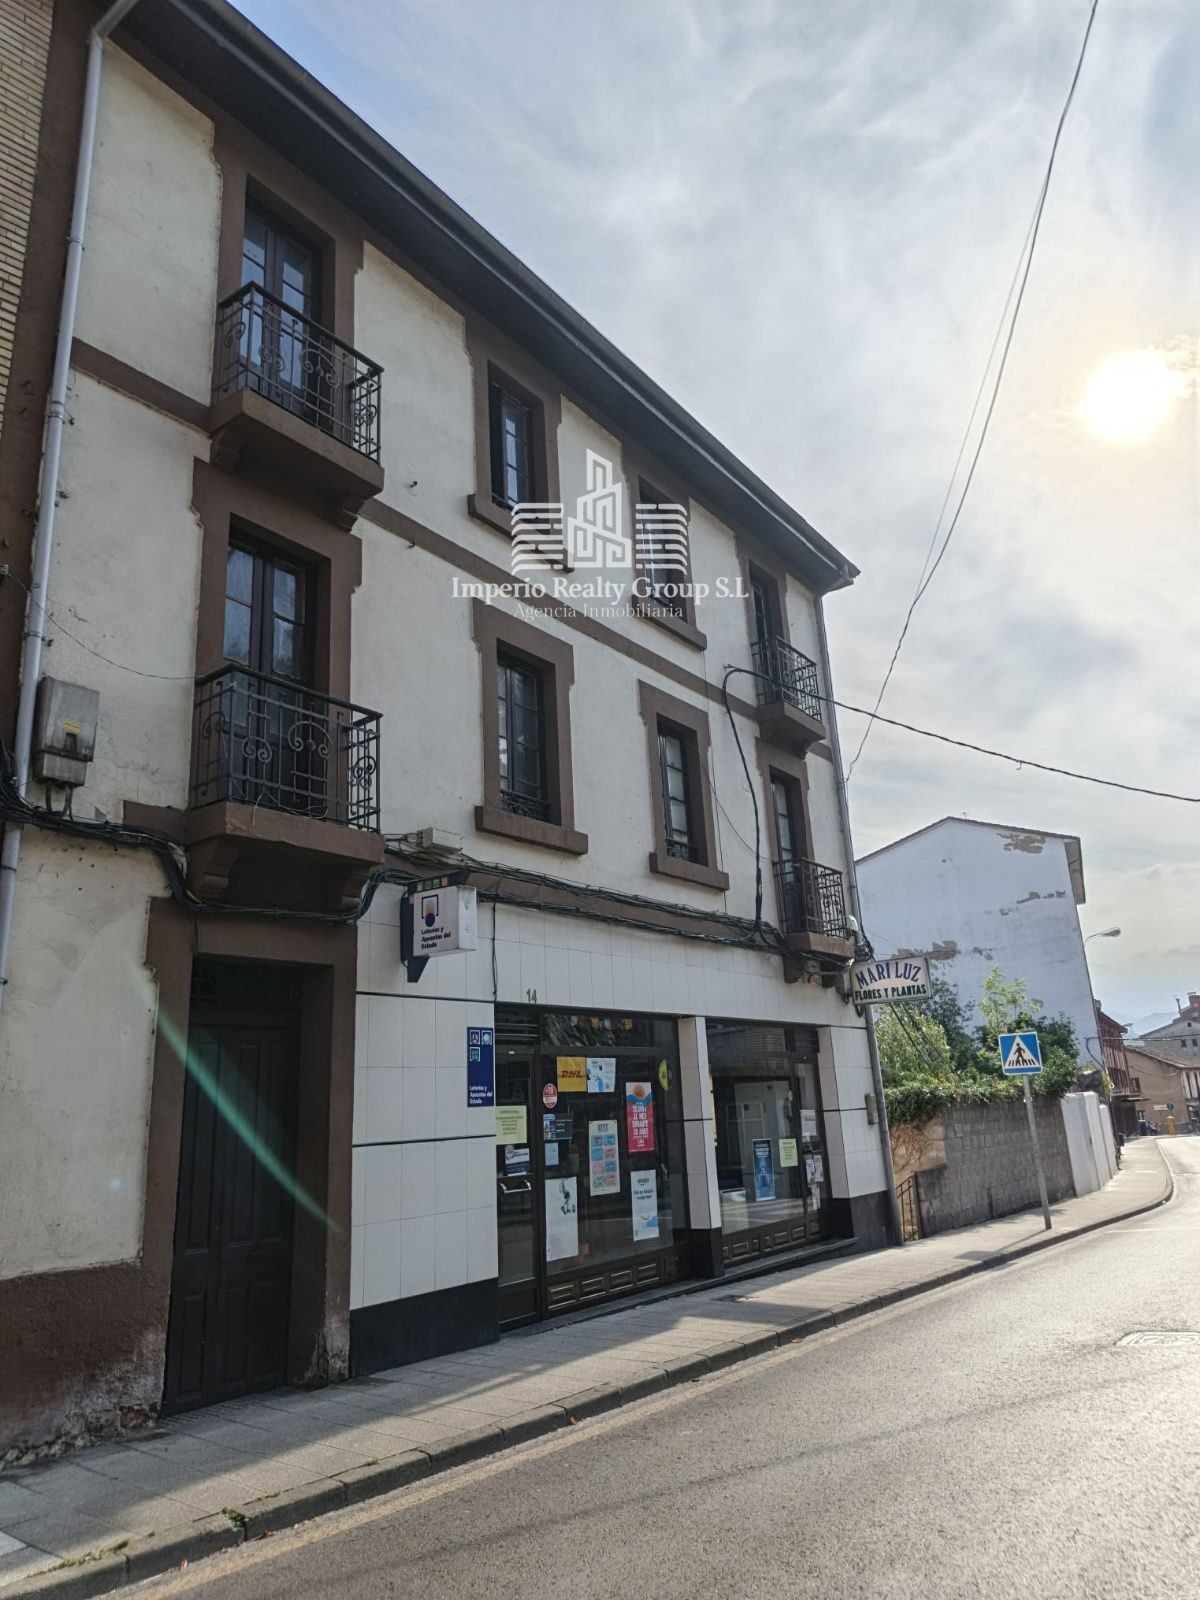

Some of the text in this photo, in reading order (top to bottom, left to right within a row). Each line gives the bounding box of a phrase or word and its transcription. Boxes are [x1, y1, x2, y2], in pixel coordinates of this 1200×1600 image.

[421, 934, 442, 942] Apuestas
[855, 961, 922, 989] MARI LUZ
[526, 989, 537, 1003] 14
[855, 984, 927, 1001] FLORES Y PLANTAS
[560, 1070, 582, 1079] DHL
